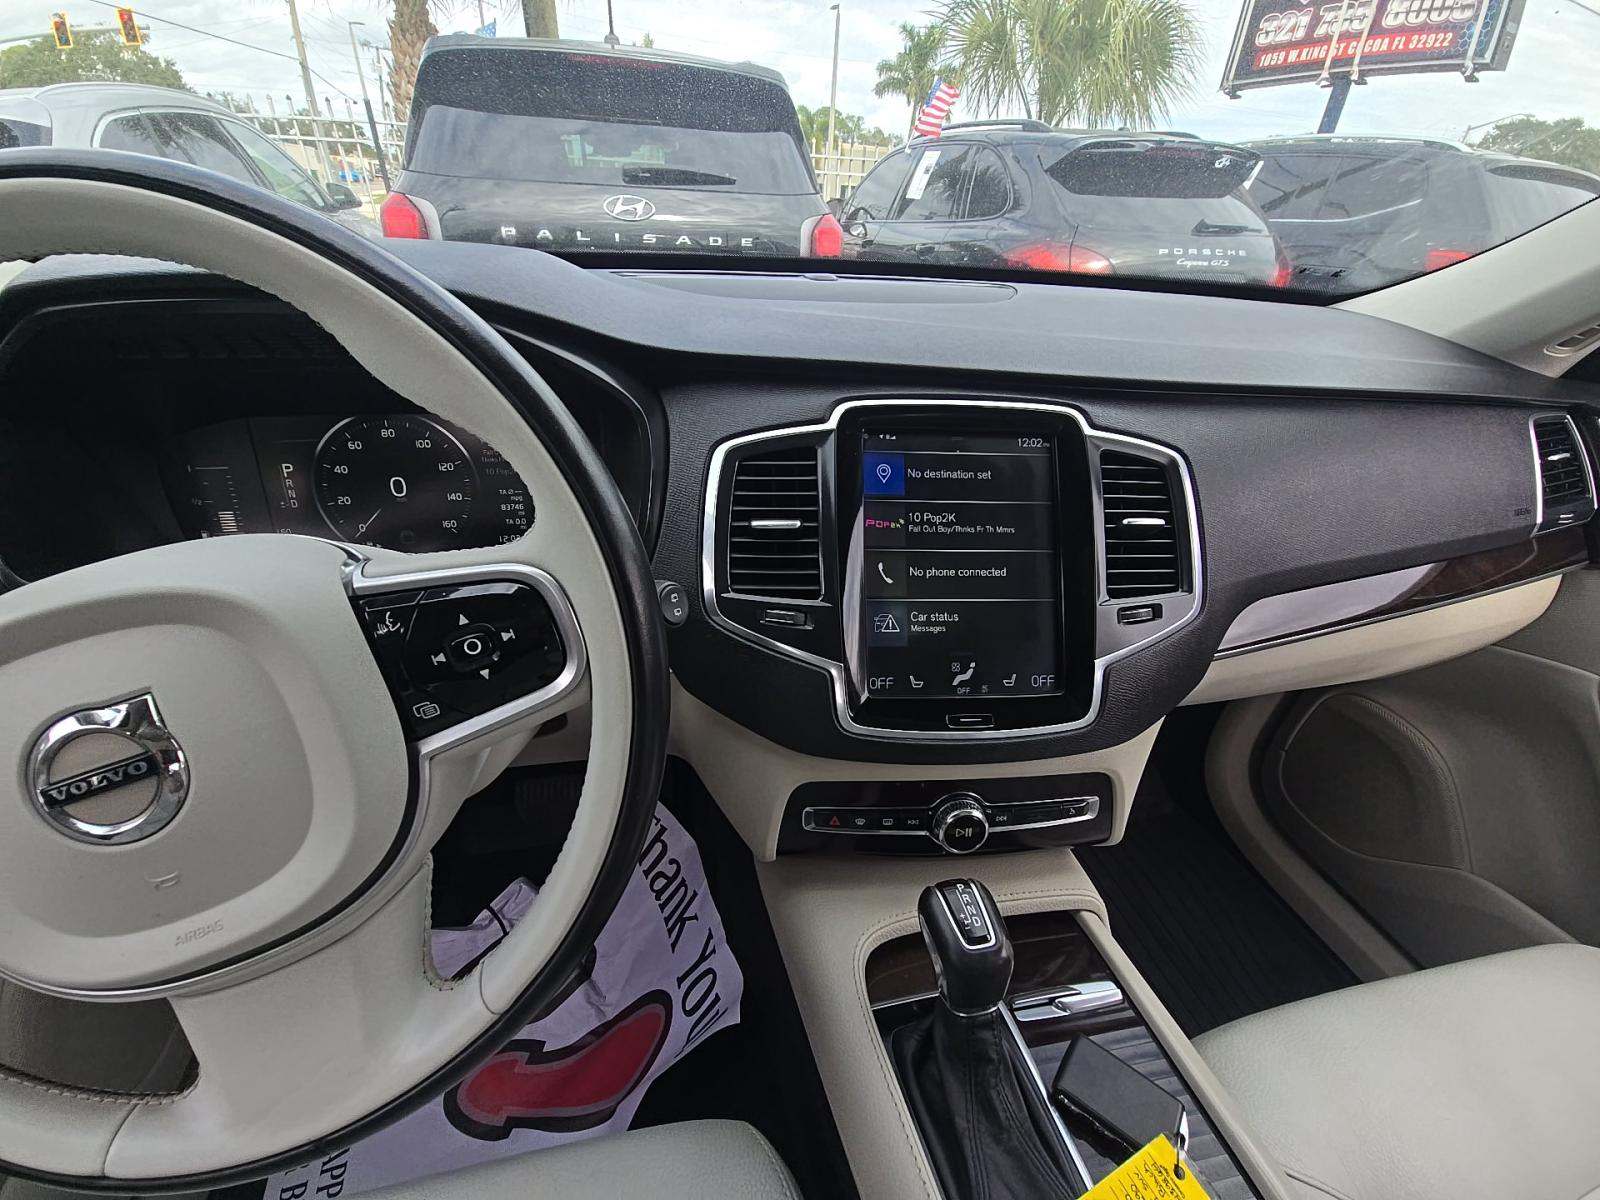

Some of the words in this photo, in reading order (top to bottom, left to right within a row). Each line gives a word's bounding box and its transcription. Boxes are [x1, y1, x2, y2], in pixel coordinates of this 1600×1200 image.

[1255, 7, 1313, 47] 321
[1259, 50, 1286, 67] 1059
[1347, 37, 1389, 55] CCOA
[1391, 36, 1406, 49] FL
[1408, 32, 1453, 49] 32922
[501, 226, 755, 248] PALISADE
[1158, 248, 1248, 257] PORSCHE
[1211, 259, 1230, 267] GTS
[381, 429, 395, 438] 80
[348, 441, 362, 450] 60
[415, 440, 431, 449] 100
[1017, 438, 1043, 448] 12:02
[281, 463, 294, 478] P
[334, 465, 348, 474] 40
[438, 463, 454, 472] 120
[907, 469, 921, 478] No
[924, 469, 975, 480] destination
[977, 470, 992, 480] set
[285, 479, 294, 488] R
[390, 476, 407, 497] 0
[288, 489, 297, 498] N
[447, 493, 462, 501] 140
[290, 499, 299, 508] D
[338, 496, 351, 505] 20
[501, 503, 524, 511] 83746
[909, 513, 921, 522] 10
[924, 513, 956, 524] Pop2K
[358, 523, 366, 532] 0
[442, 520, 457, 529] 160
[908, 525, 921, 533] Fall
[923, 525, 936, 533] Out
[910, 567, 923, 577] No
[926, 567, 956, 579] phone
[958, 567, 1007, 577] connected
[910, 612, 928, 621] Car
[930, 612, 959, 621] status
[910, 625, 946, 633] Messages
[869, 677, 894, 690] OFF
[957, 687, 971, 695] OFF
[1031, 675, 1055, 688] OFF
[50, 761, 148, 800] VOLVO
[962, 894, 972, 904] R
[967, 906, 976, 916] N
[972, 916, 982, 927] D
[174, 918, 225, 948] AIRBAG
